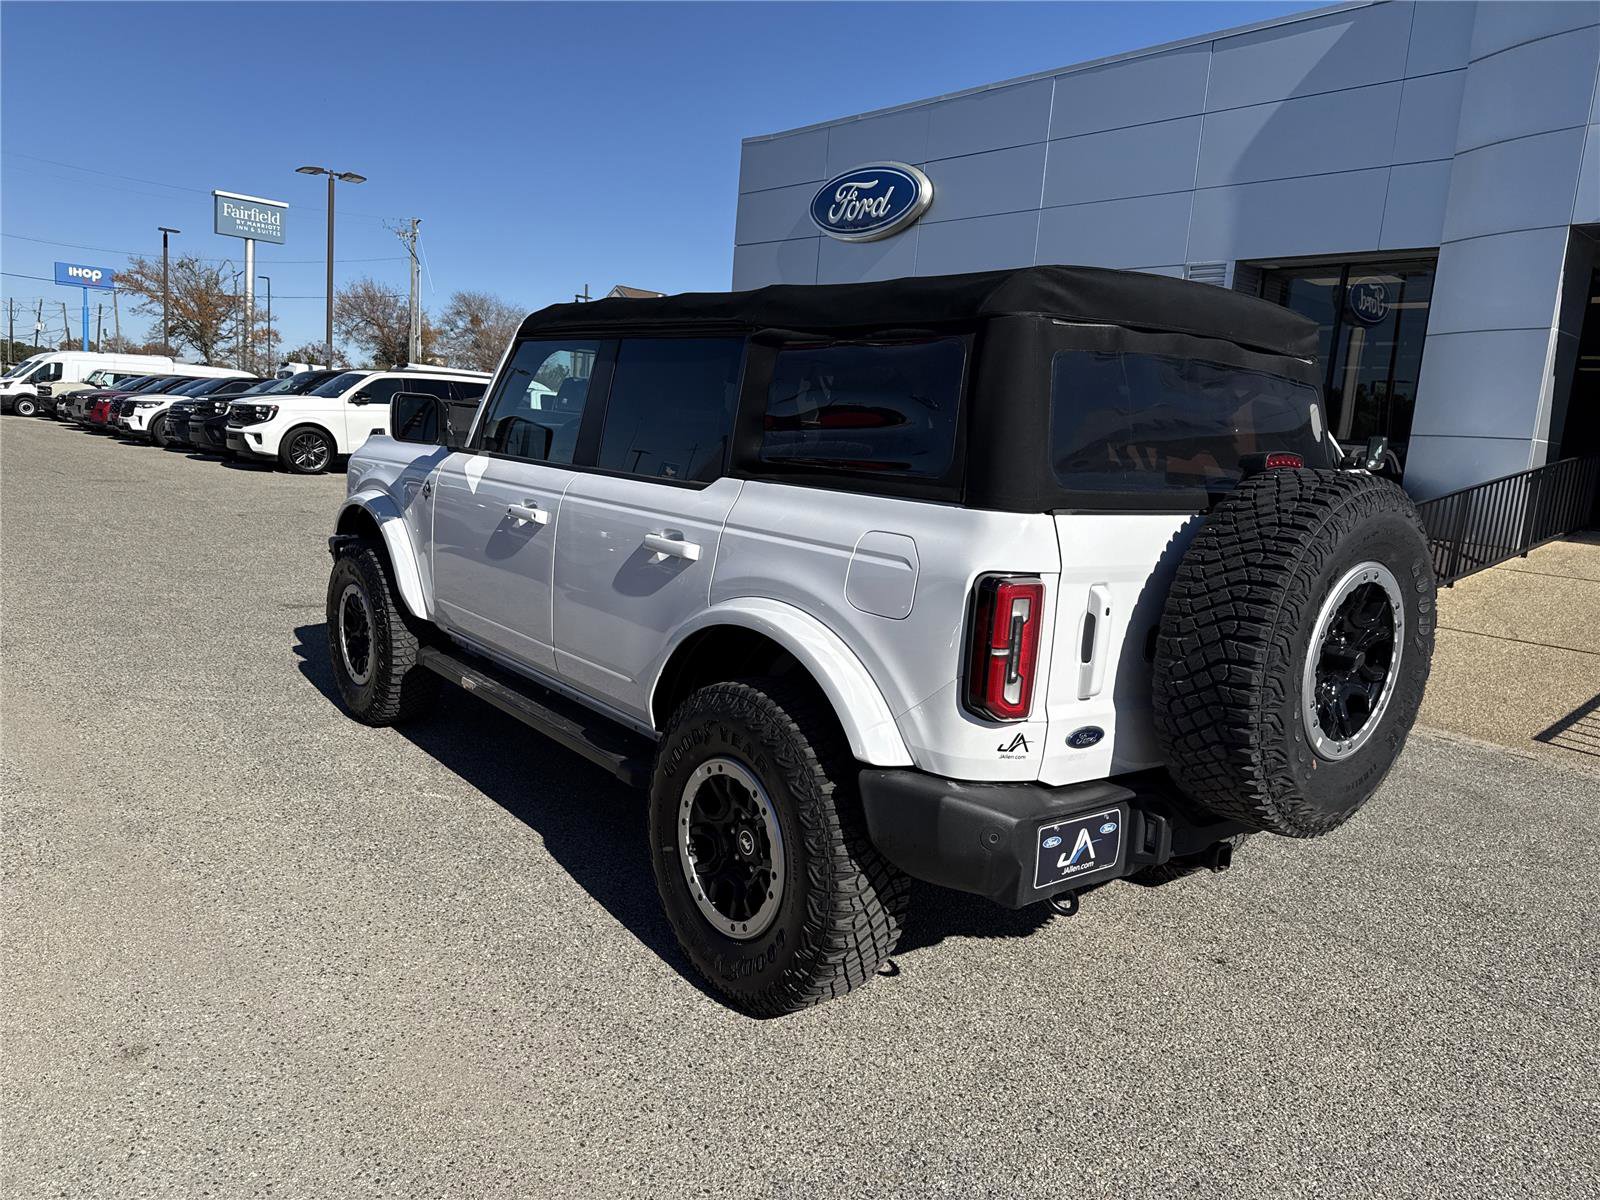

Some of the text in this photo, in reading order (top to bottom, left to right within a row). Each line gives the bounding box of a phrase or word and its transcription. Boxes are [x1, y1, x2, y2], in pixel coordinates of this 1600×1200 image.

[828, 180, 895, 224] Ford
[223, 203, 280, 225] Fairfield
[247, 221, 281, 231] MARRIOTT
[257, 228, 281, 237] SUITES
[1056, 827, 1096, 868] JA
[1061, 860, 1095, 876] JAllen.com
